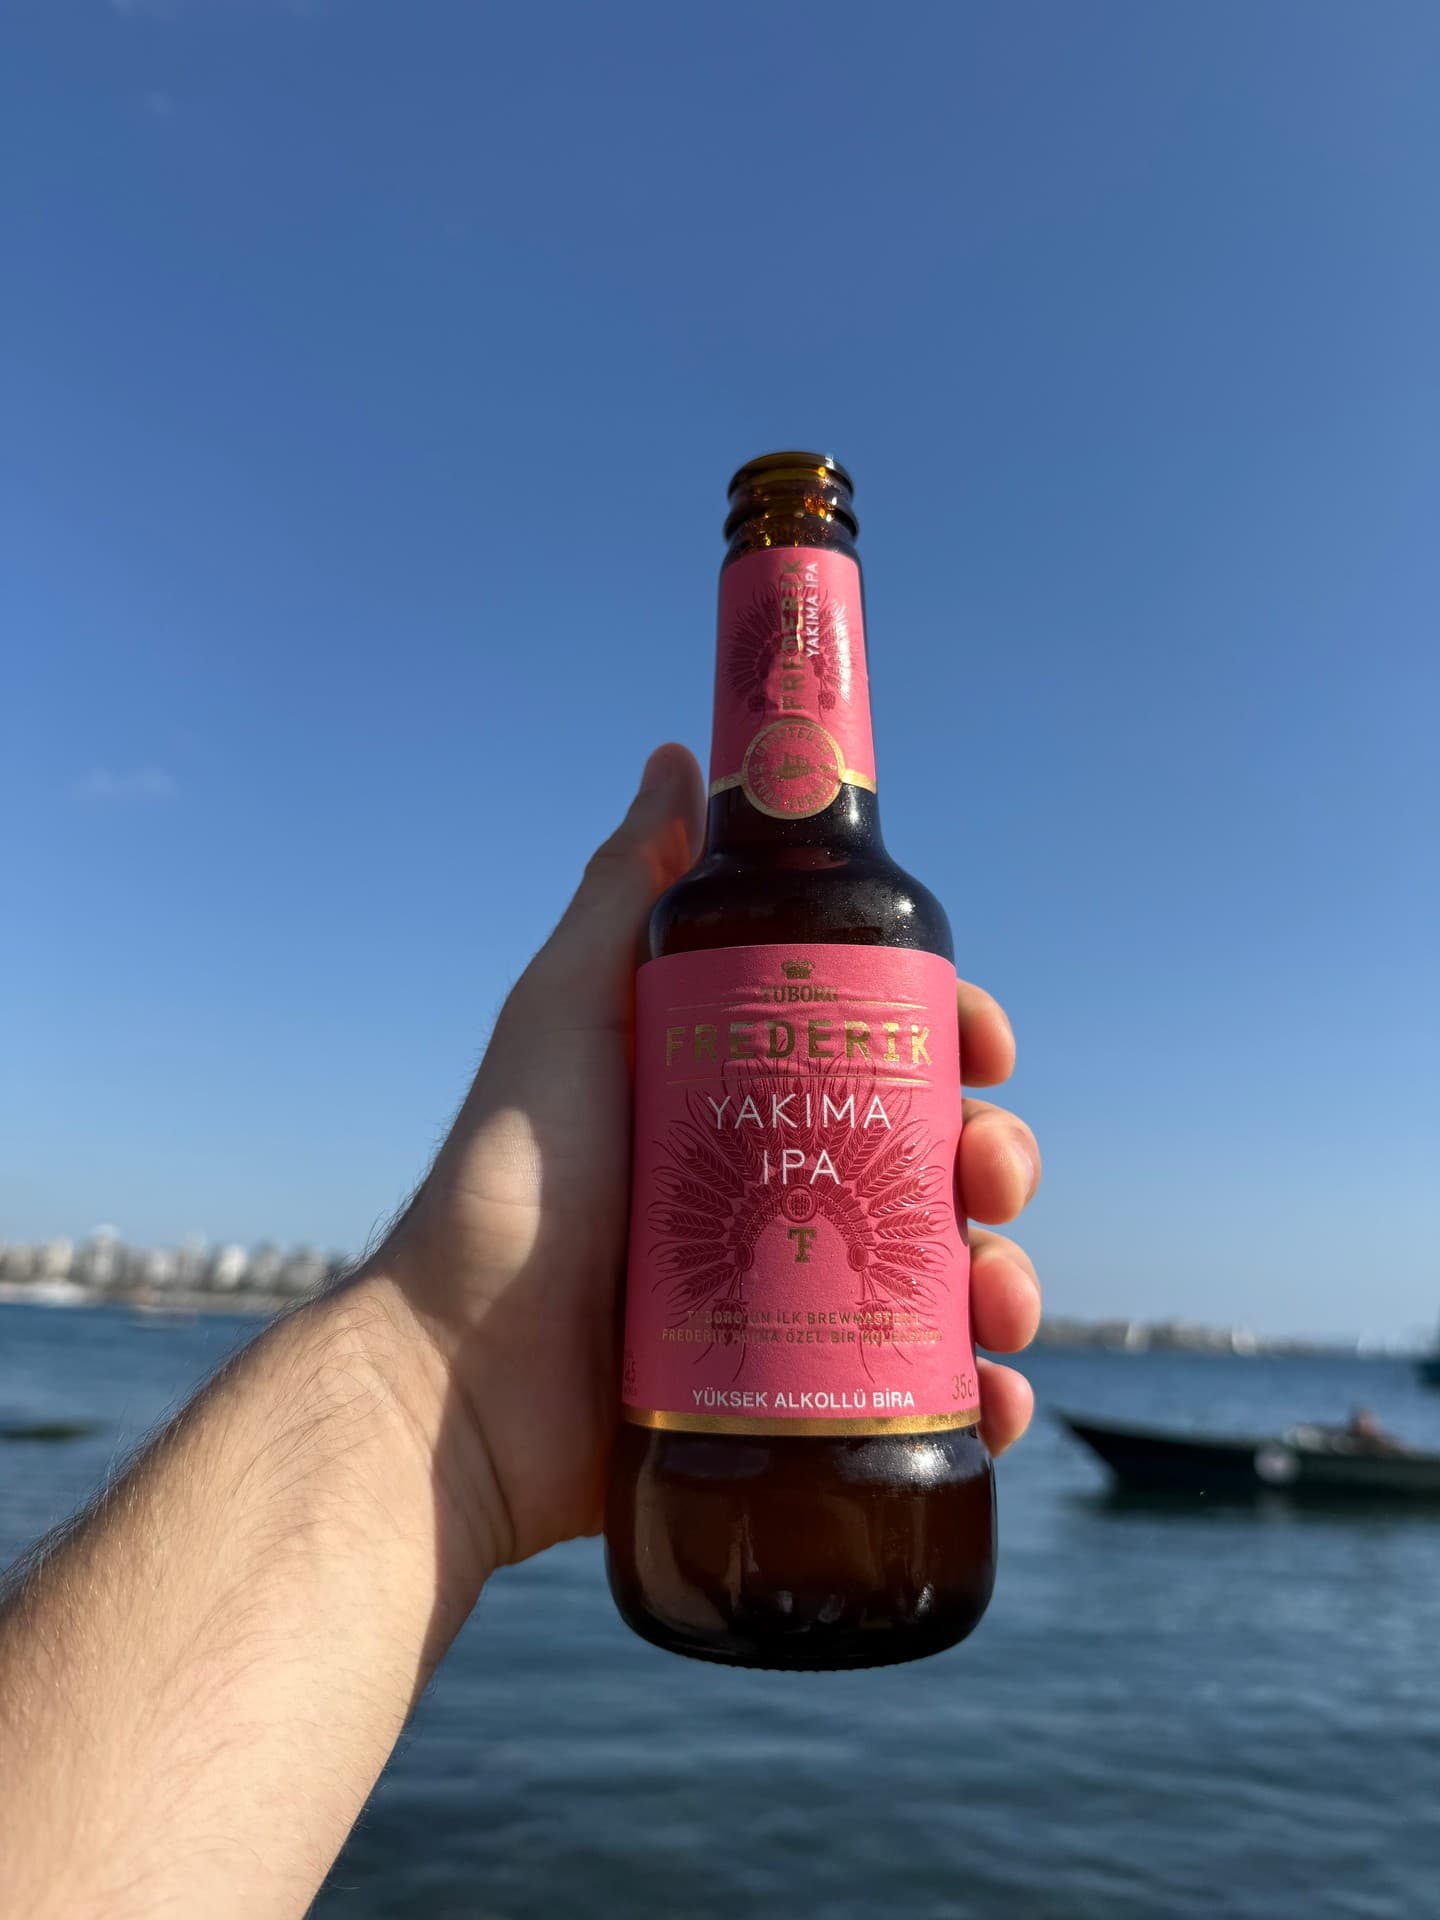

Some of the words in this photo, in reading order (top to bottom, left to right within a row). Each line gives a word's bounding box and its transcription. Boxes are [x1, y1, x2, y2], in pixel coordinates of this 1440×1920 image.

[805, 562, 818, 588] IPA
[806, 595, 820, 658] YAKIMA
[665, 1020, 933, 1066] FREDERIK
[707, 1094, 892, 1130] YAKIMA
[762, 1149, 841, 1185] IPA
[786, 1327, 825, 1343] ÖZEL
[692, 1387, 768, 1408] YÜKSEK
[774, 1388, 866, 1409] ALKOLLÜ
[873, 1387, 915, 1408] BİRA
